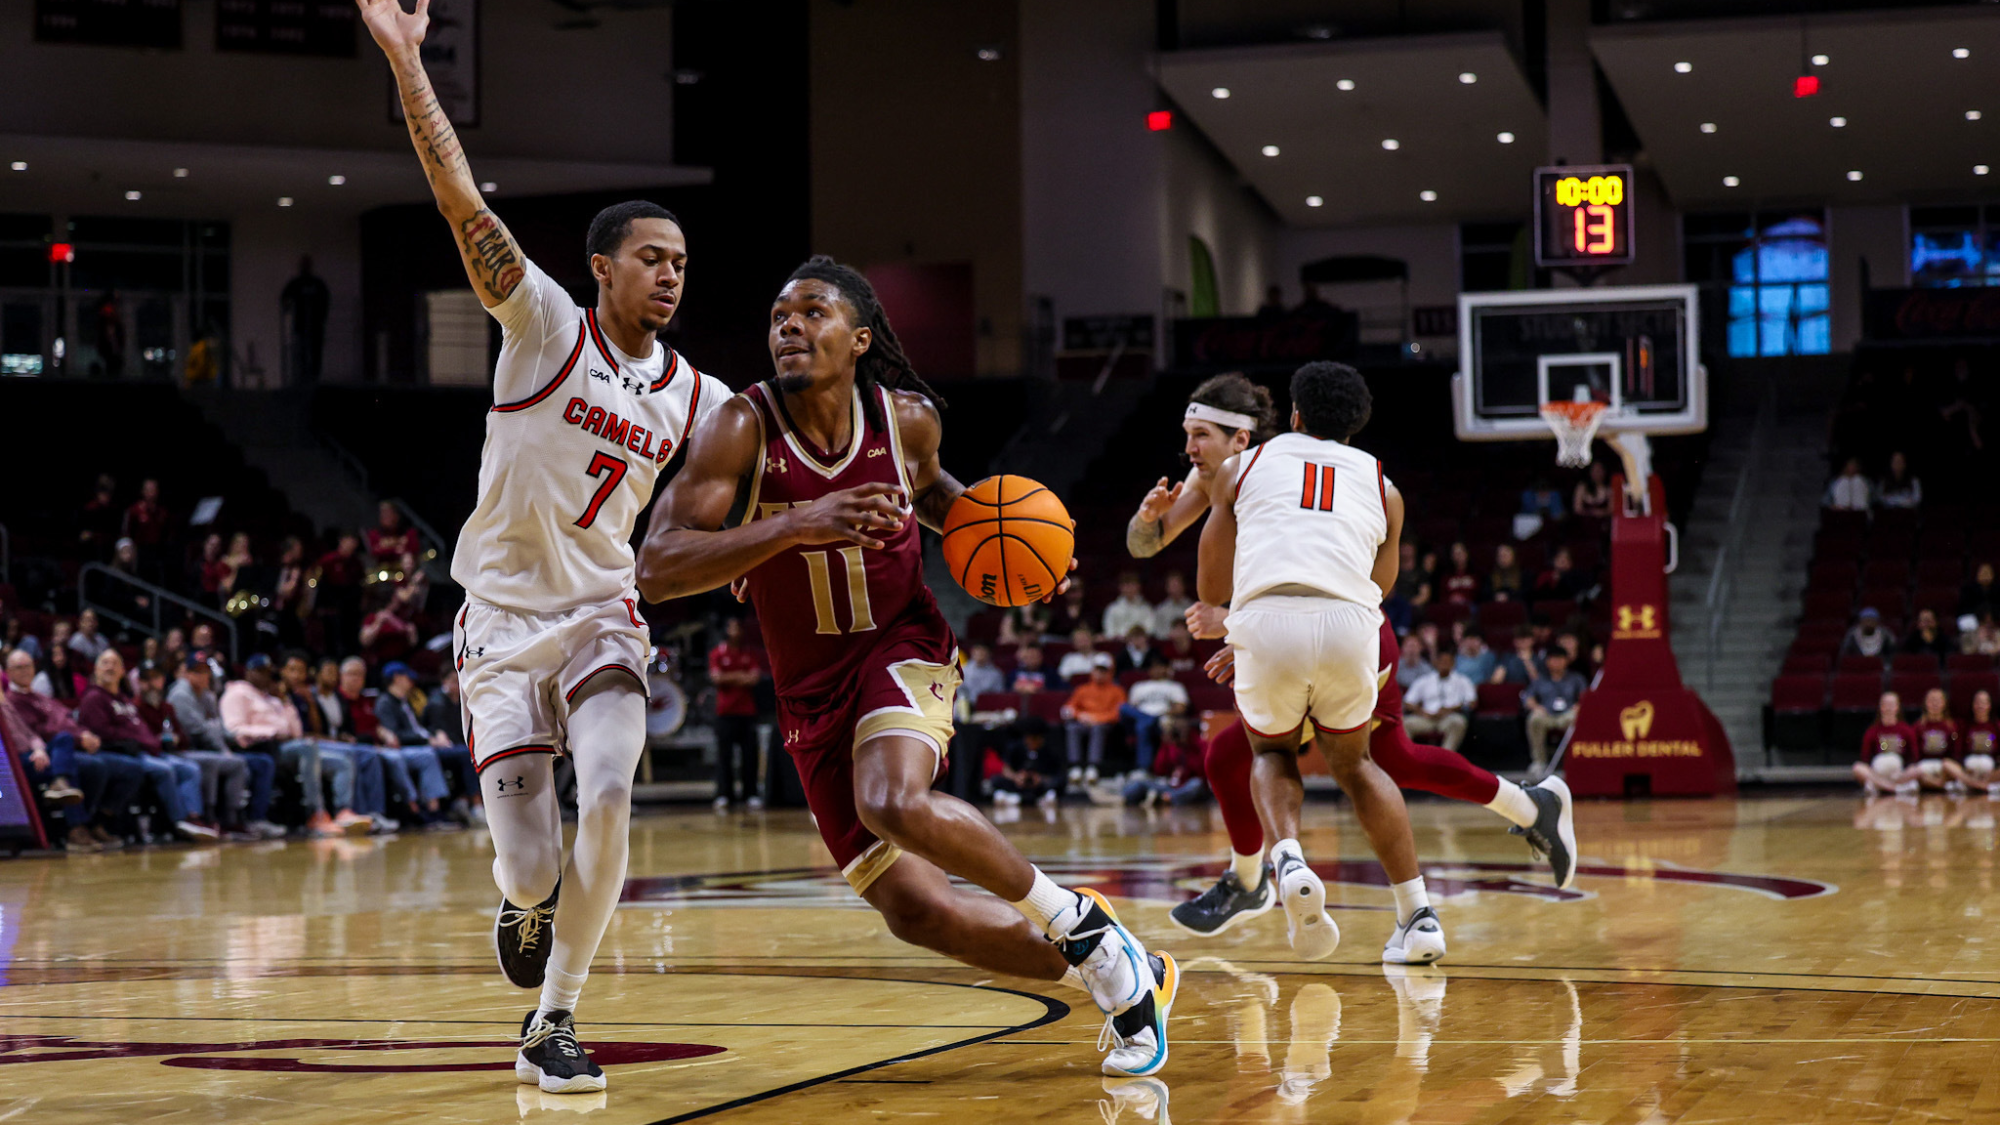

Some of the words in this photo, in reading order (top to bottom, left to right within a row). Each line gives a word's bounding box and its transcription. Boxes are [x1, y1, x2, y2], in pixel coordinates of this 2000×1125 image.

[1556, 175, 1623, 207] 10:00
[1574, 204, 1615, 254] 13
[589, 368, 610, 384] CAA
[563, 397, 672, 464] CAMELS
[867, 446, 887, 458] CAA
[572, 450, 628, 529] 7
[1300, 461, 1335, 512] 11
[799, 545, 878, 635] 11
[1572, 740, 1635, 759] FULLER
[1636, 739, 1703, 758] DENTAL
